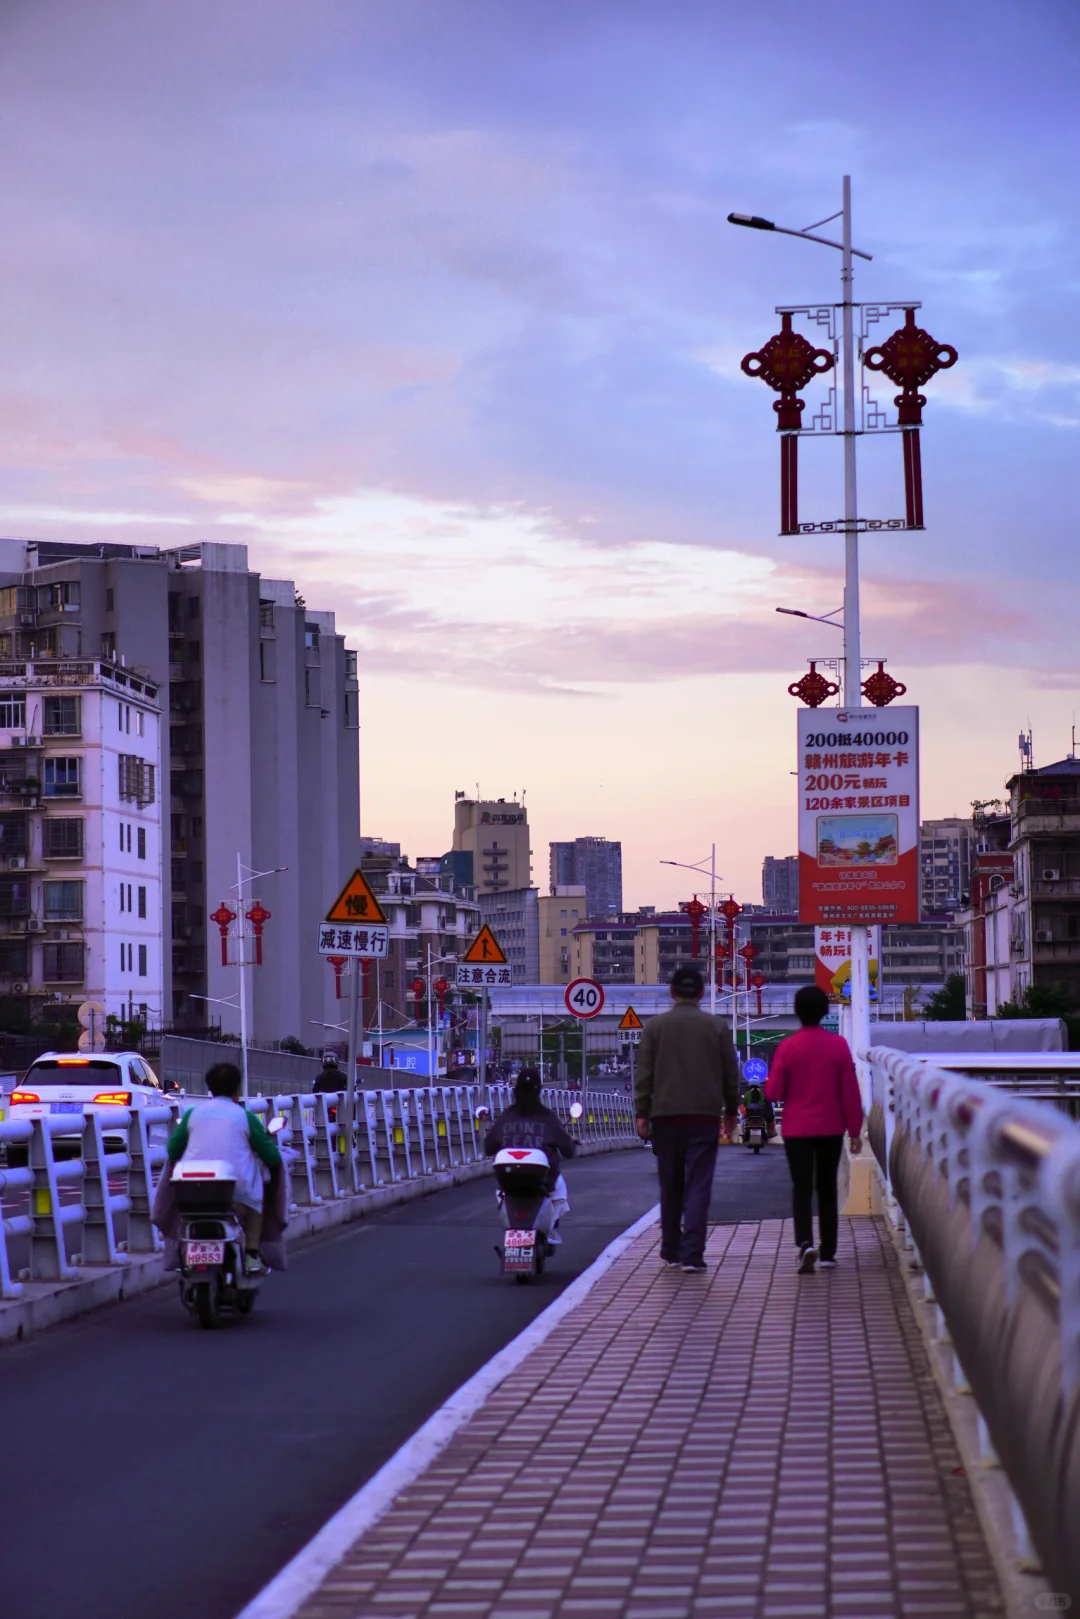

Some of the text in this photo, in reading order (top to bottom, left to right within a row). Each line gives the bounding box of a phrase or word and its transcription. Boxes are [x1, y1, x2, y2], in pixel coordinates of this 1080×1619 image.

[805, 731, 909, 748] 200抵40000
[804, 751, 909, 770] 赣州旅游年卡
[804, 794, 910, 811] 120余家景区项目
[344, 894, 369, 916] 慢
[320, 929, 388, 952] 减速慢行
[457, 967, 511, 985] 注意合流
[573, 988, 597, 1007] 40
[502, 1122, 546, 1134] DON'T
[502, 1135, 543, 1147] FEAR
[188, 1253, 221, 1263] H9553
